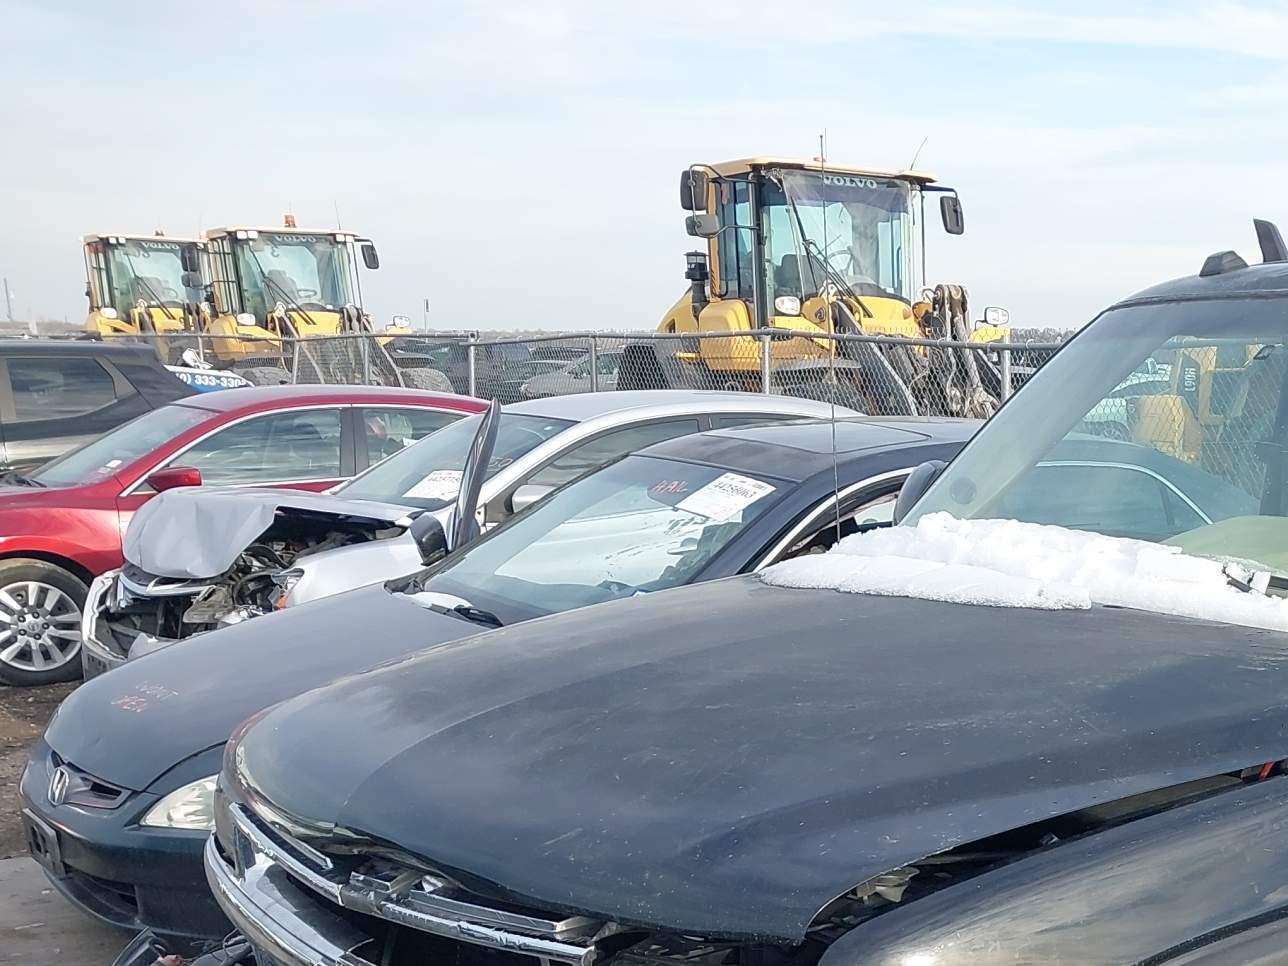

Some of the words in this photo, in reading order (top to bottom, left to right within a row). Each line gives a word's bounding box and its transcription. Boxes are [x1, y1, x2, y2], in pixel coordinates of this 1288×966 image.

[818, 175, 878, 189] VOLVO
[275, 234, 317, 244] VOLVO
[141, 241, 180, 250] VOLVO
